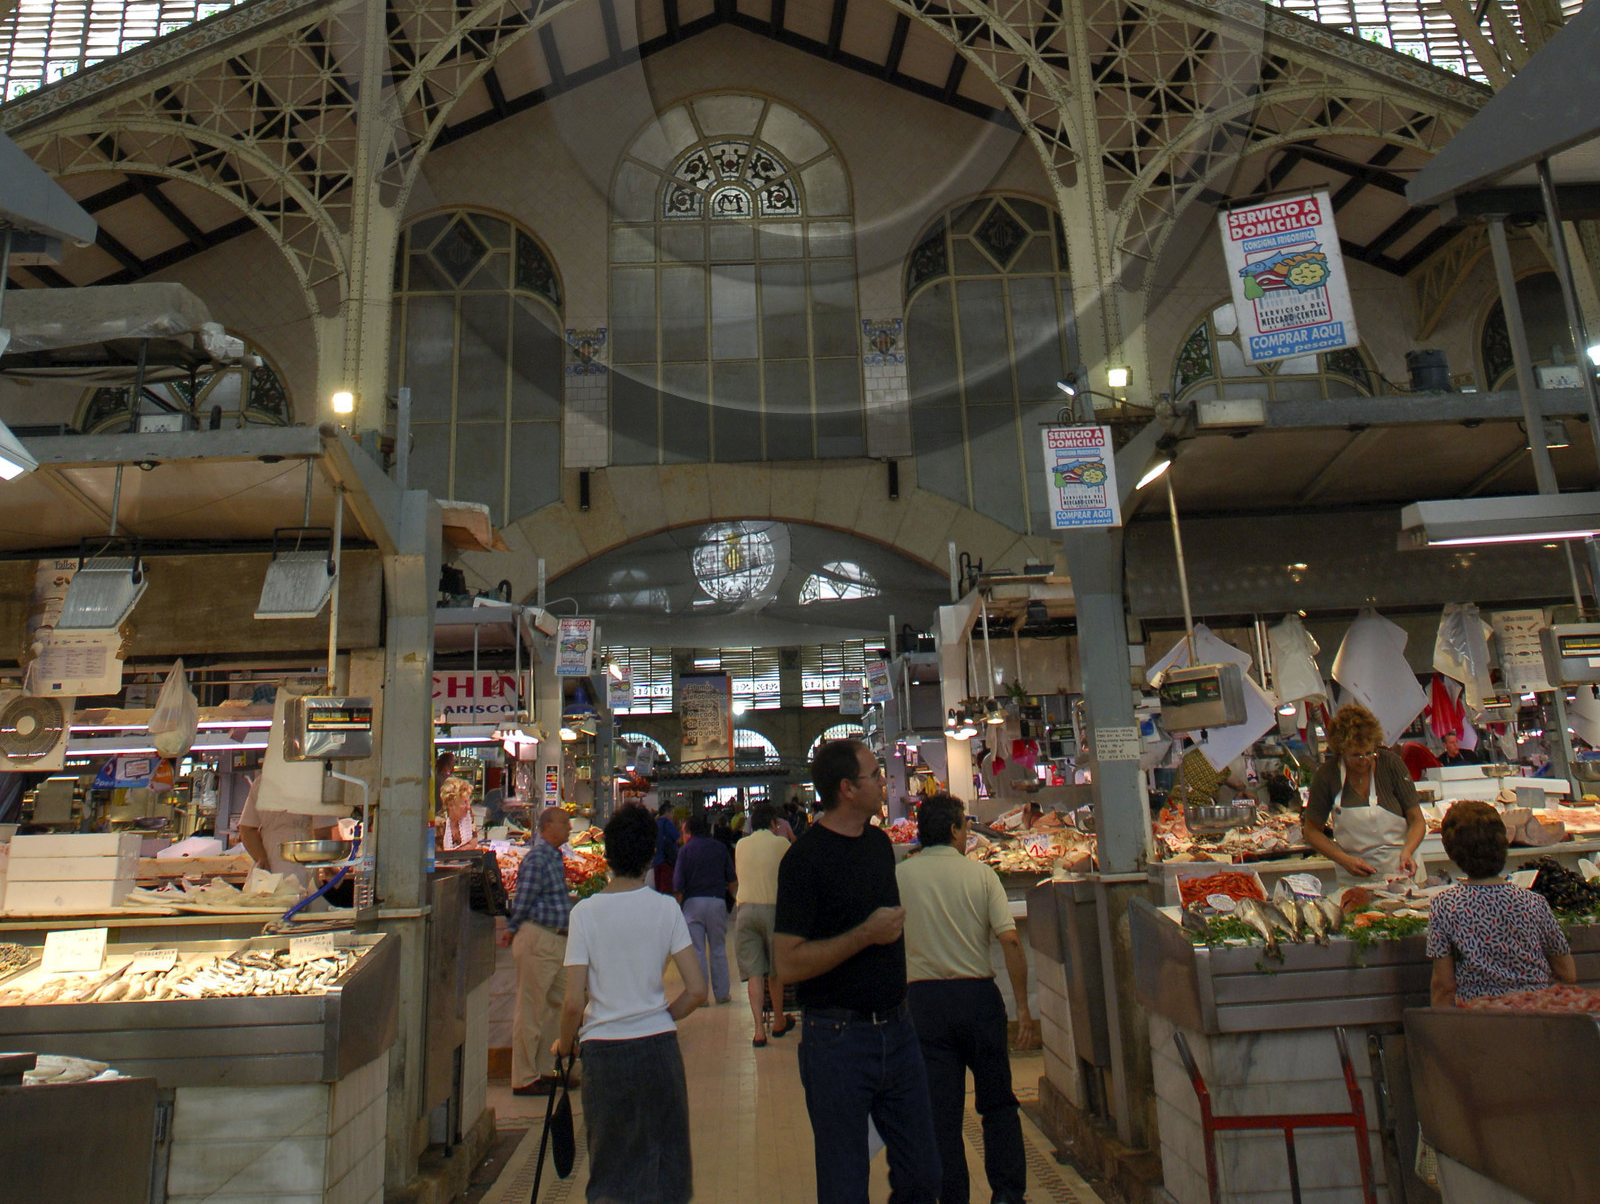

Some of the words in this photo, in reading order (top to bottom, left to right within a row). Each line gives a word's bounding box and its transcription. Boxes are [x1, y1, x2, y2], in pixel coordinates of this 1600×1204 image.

[1229, 204, 1300, 226] SERVICIO
[1304, 200, 1316, 213] A
[1231, 213, 1320, 239] DOMICILIO
[1244, 237, 1277, 251] CONSIGNA
[1260, 305, 1306, 318] SERVICIOS
[1310, 301, 1326, 309] DEL
[1262, 313, 1294, 327] MERCADO
[1297, 308, 1328, 320] CENTRAL
[1252, 329, 1308, 349] COMPRAR
[1312, 323, 1341, 340] AQUI
[1256, 350, 1273, 358] no
[1295, 337, 1343, 354] pesará
[1048, 431, 1092, 440] SERVICIO
[1049, 438, 1104, 448] DOMICILIO
[1056, 510, 1091, 520] COMPRAR
[1093, 509, 1112, 518] AQUI
